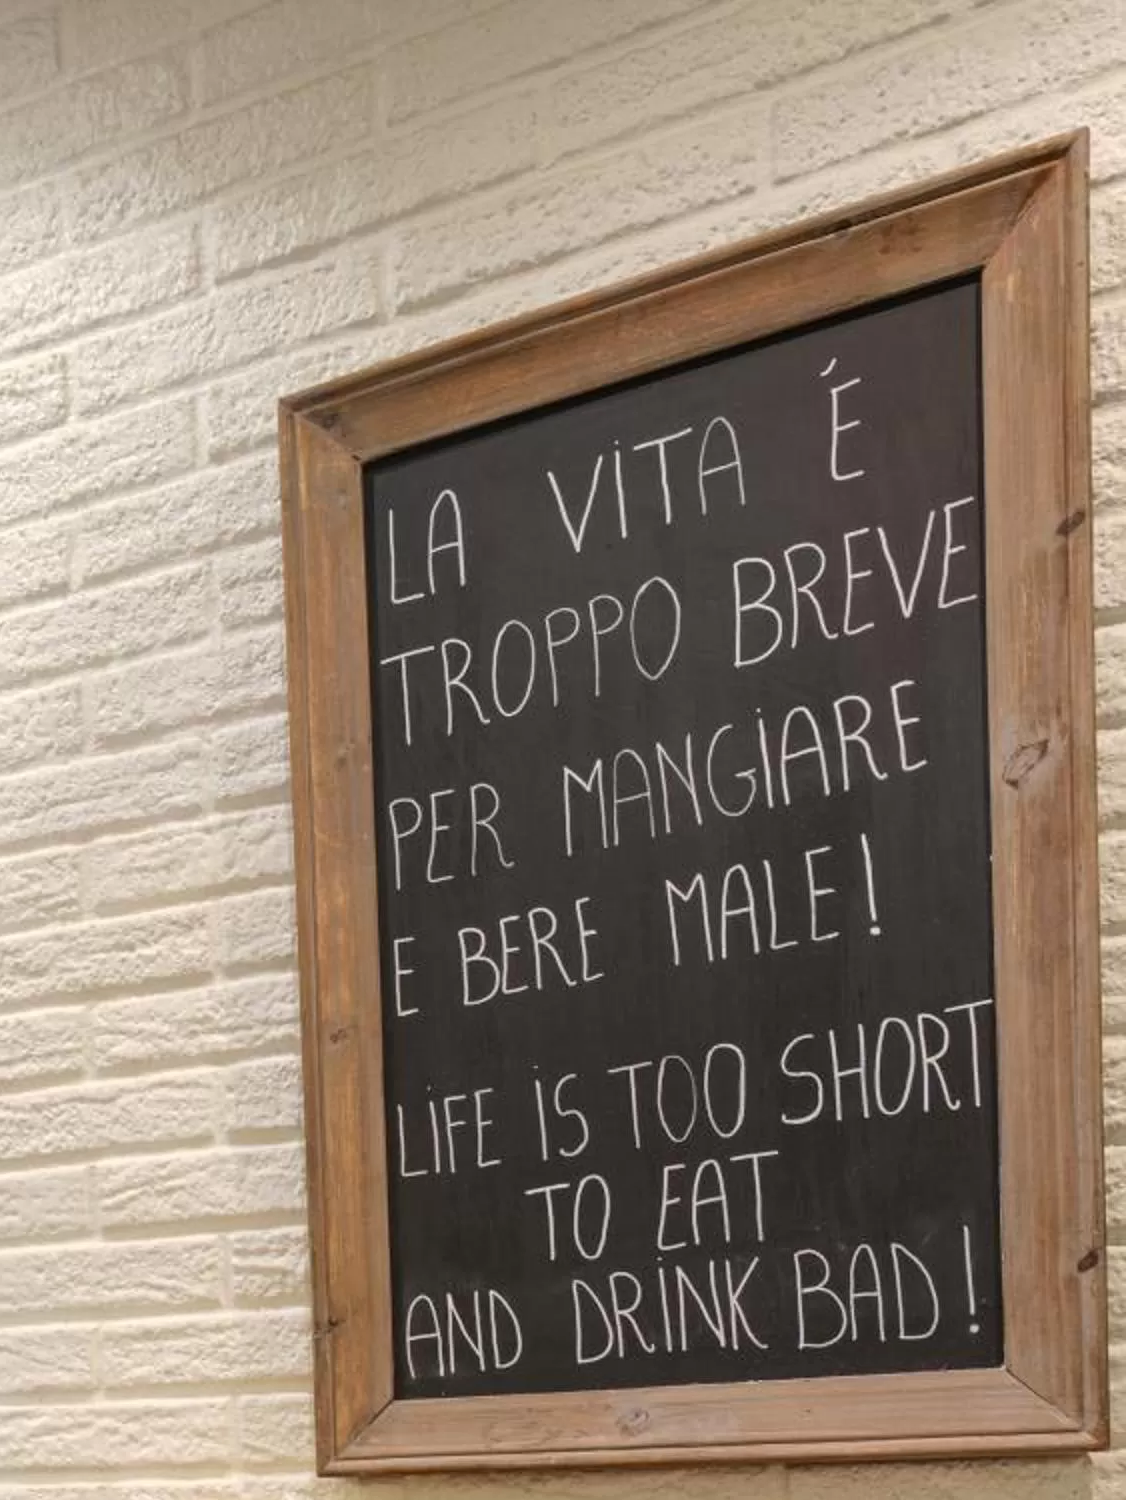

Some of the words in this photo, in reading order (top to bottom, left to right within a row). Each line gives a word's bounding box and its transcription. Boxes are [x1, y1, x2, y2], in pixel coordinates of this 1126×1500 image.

[388, 489, 466, 605] LA
[382, 576, 682, 746] TROPPO
[733, 497, 978, 668] BREVE
[388, 783, 514, 891] PER
[394, 936, 418, 1017] E
[458, 896, 605, 1008] BERE
[608, 1043, 746, 1149] TOO
[781, 1000, 993, 1125] SHORT
[525, 1173, 611, 1261] TO
[656, 1151, 779, 1251] EAT
[404, 1289, 523, 1379] AND
